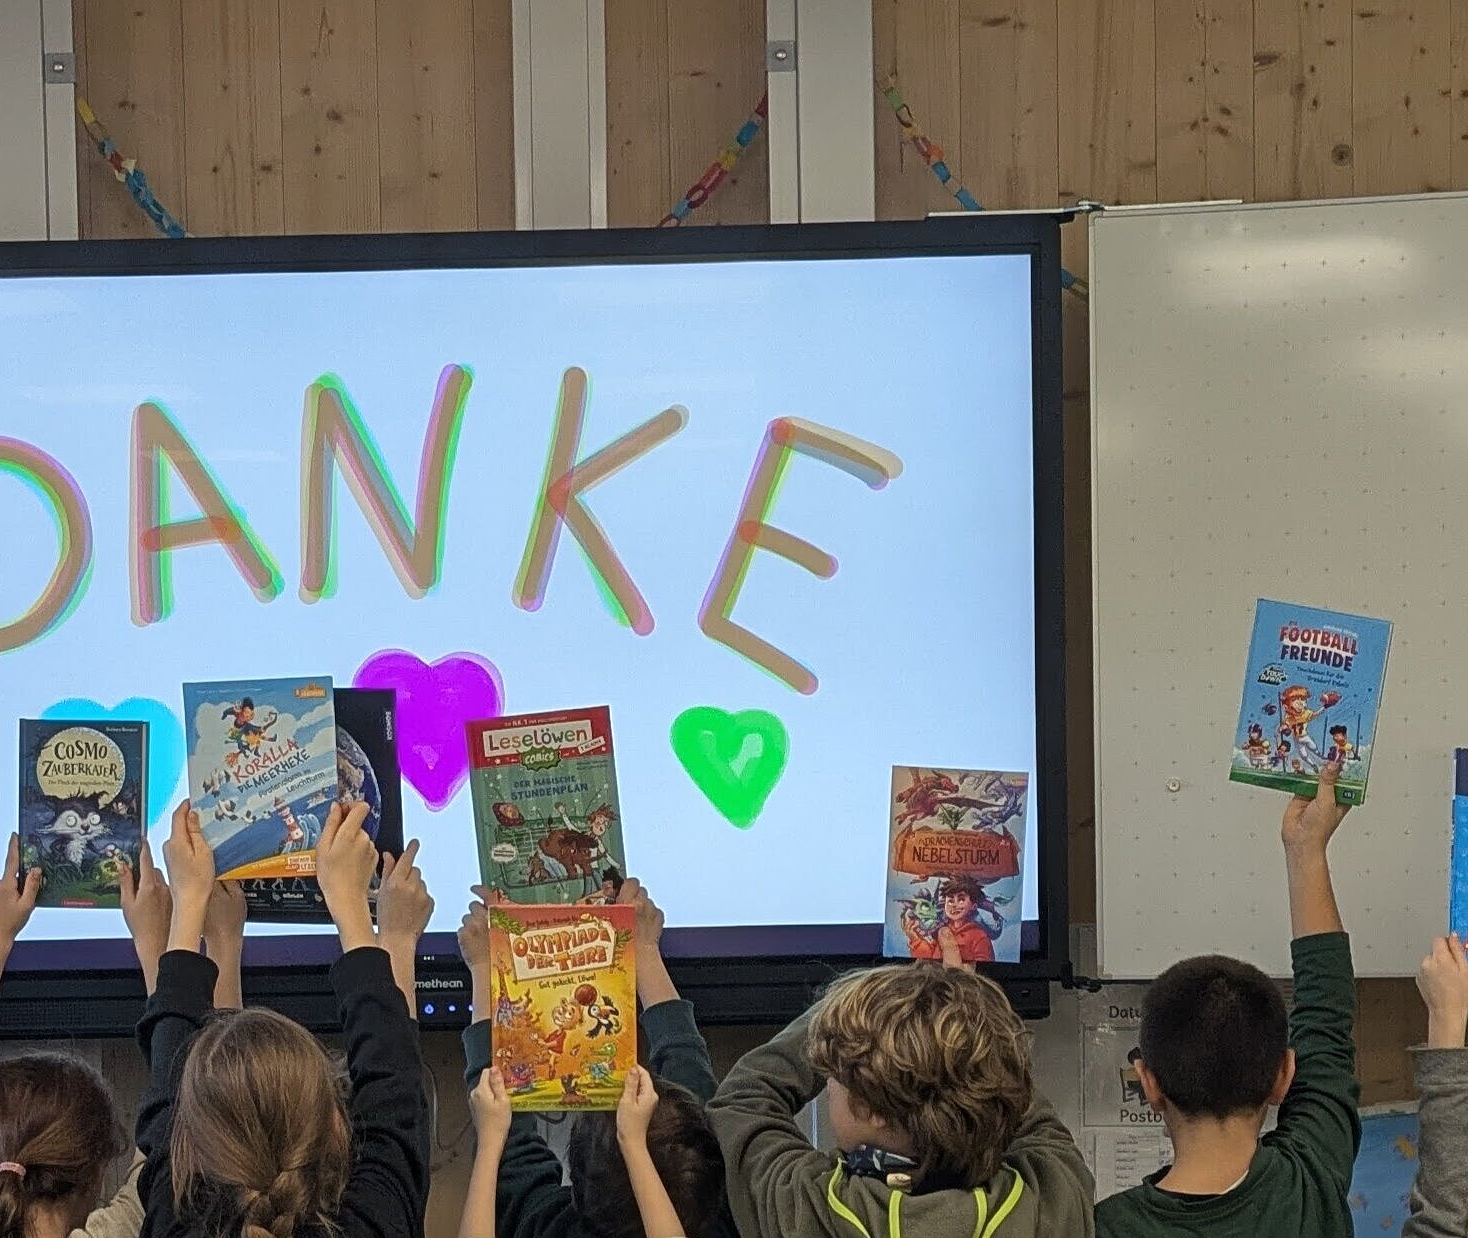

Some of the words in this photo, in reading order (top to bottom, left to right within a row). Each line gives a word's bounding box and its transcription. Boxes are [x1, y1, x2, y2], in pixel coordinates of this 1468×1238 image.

[1279, 625, 1359, 656] FOOTBALL
[1280, 644, 1353, 672] FREUNDE
[488, 727, 588, 752] Leselöwen
[232, 738, 300, 784] KORALLA
[253, 748, 311, 789] MEERHEXE
[510, 782, 589, 801] STUNDENPLAN
[912, 846, 1000, 866] NEBELSTURM
[512, 926, 612, 957] OLYMPIADE
[527, 954, 553, 970] DER
[554, 946, 607, 972] TIERE
[413, 978, 464, 990] methean
